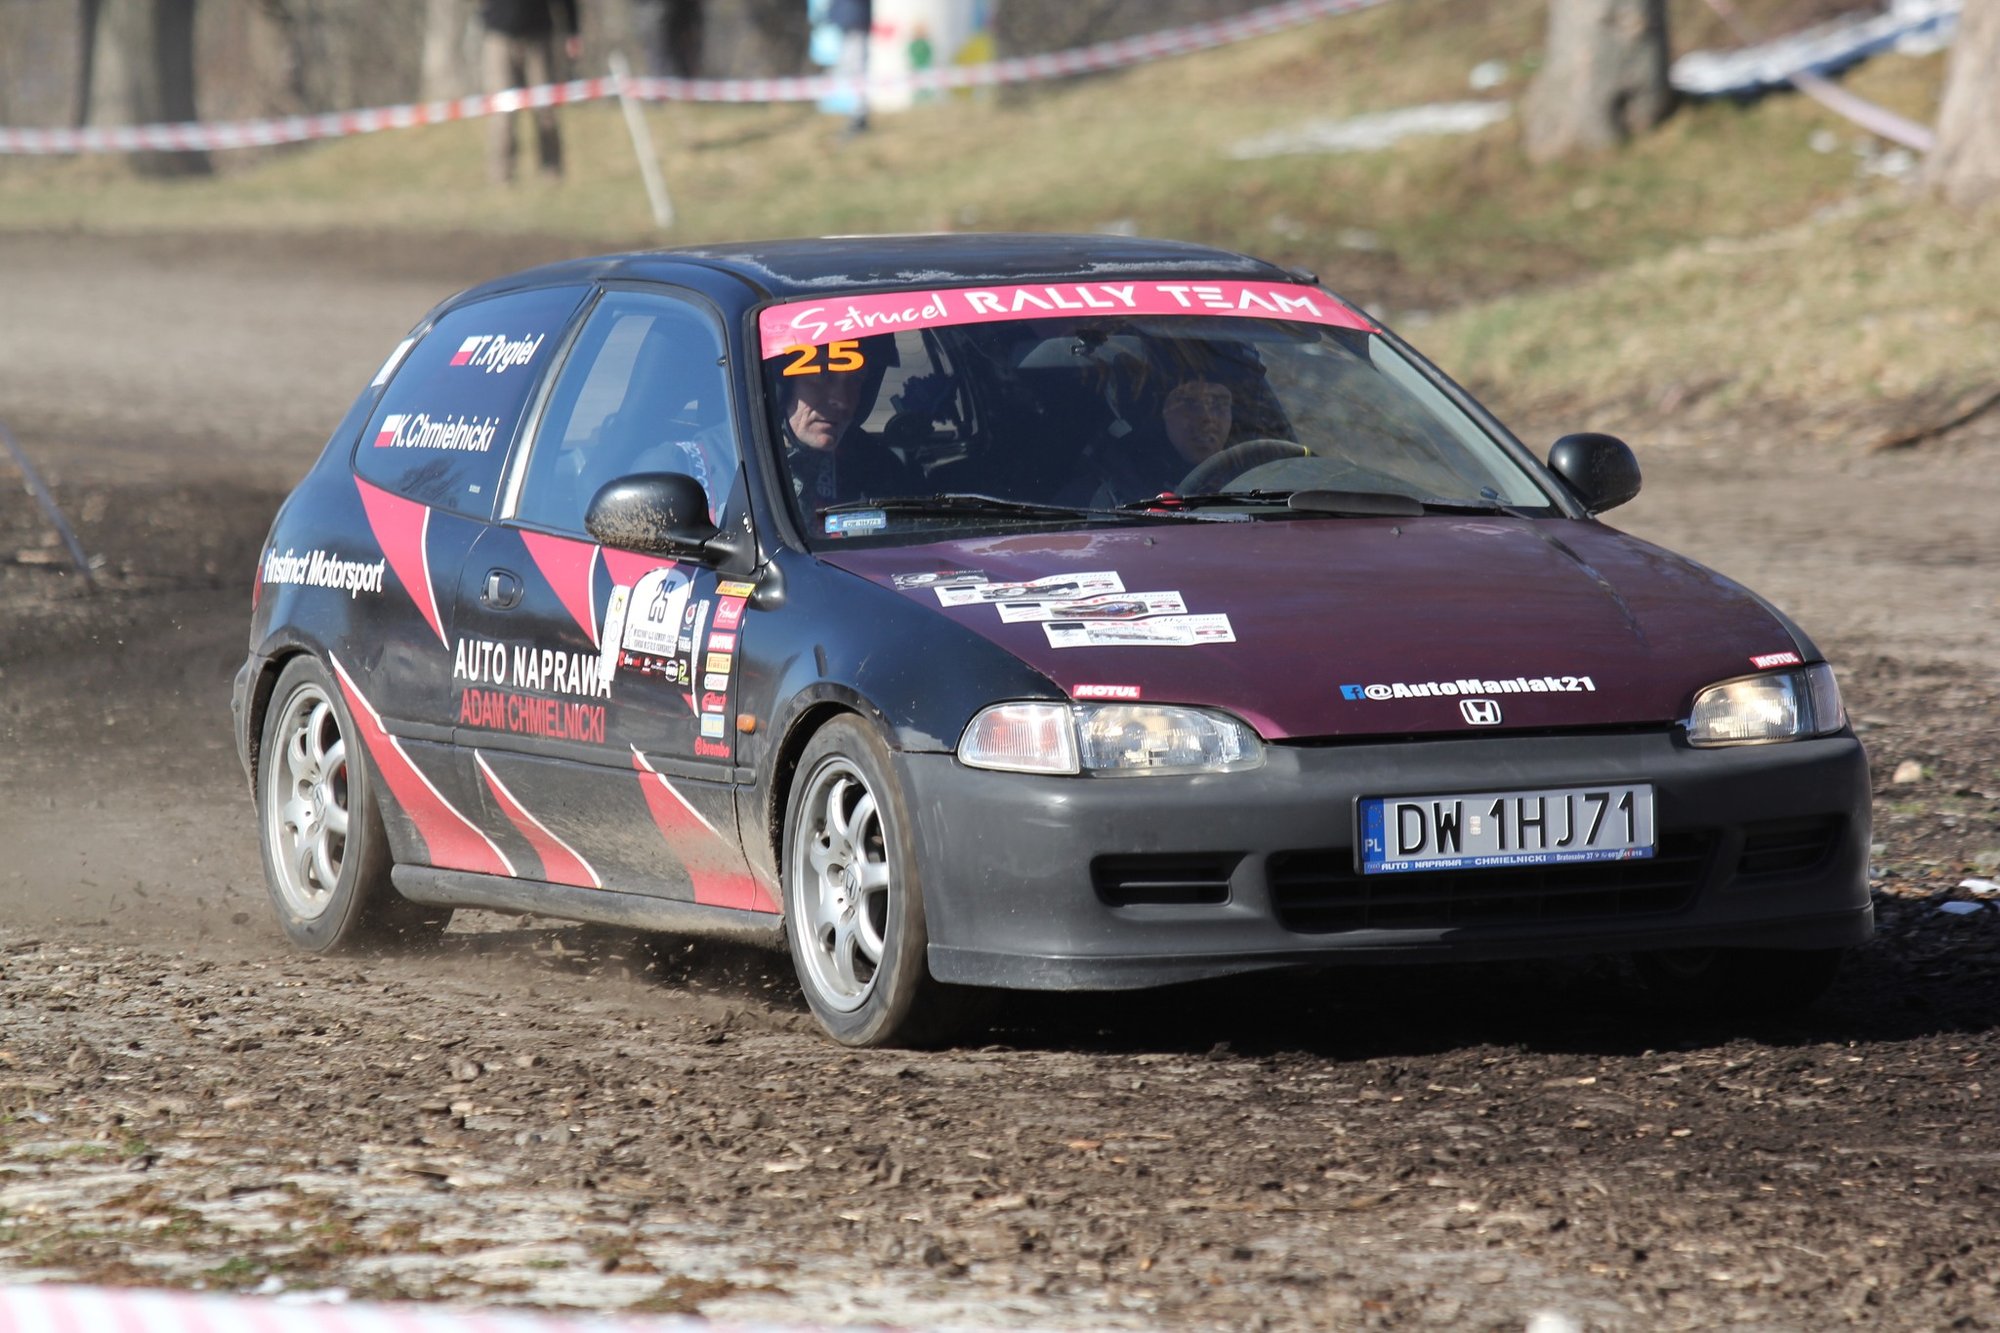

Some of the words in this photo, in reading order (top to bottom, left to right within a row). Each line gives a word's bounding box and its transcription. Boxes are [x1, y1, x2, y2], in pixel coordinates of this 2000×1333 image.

[790, 293, 948, 341] Sztrucel
[964, 285, 1137, 315] RALLY
[1156, 285, 1323, 317] TEAM
[469, 333, 545, 374] T.Rygiel
[783, 340, 865, 377] 25
[390, 413, 500, 452] K.Chmielnicki
[305, 550, 386, 598] Motorsport
[647, 579, 676, 624] 25
[454, 638, 507, 684] AUTO
[1755, 652, 1799, 668] MOTUL
[1076, 686, 1138, 698] MOTUL
[1364, 676, 1596, 700] @AutoManiak21
[460, 688, 505, 730] ADAM
[508, 698, 606, 743] CHMIELNICKI
[1395, 801, 1462, 855] DW
[1487, 790, 1636, 852] 1HJ71
[1364, 837, 1382, 853] PL
[1381, 862, 1408, 871] AUTO
[1415, 859, 1462, 869] NAPRAWA
[1475, 855, 1547, 866] CHMIELNICKI
